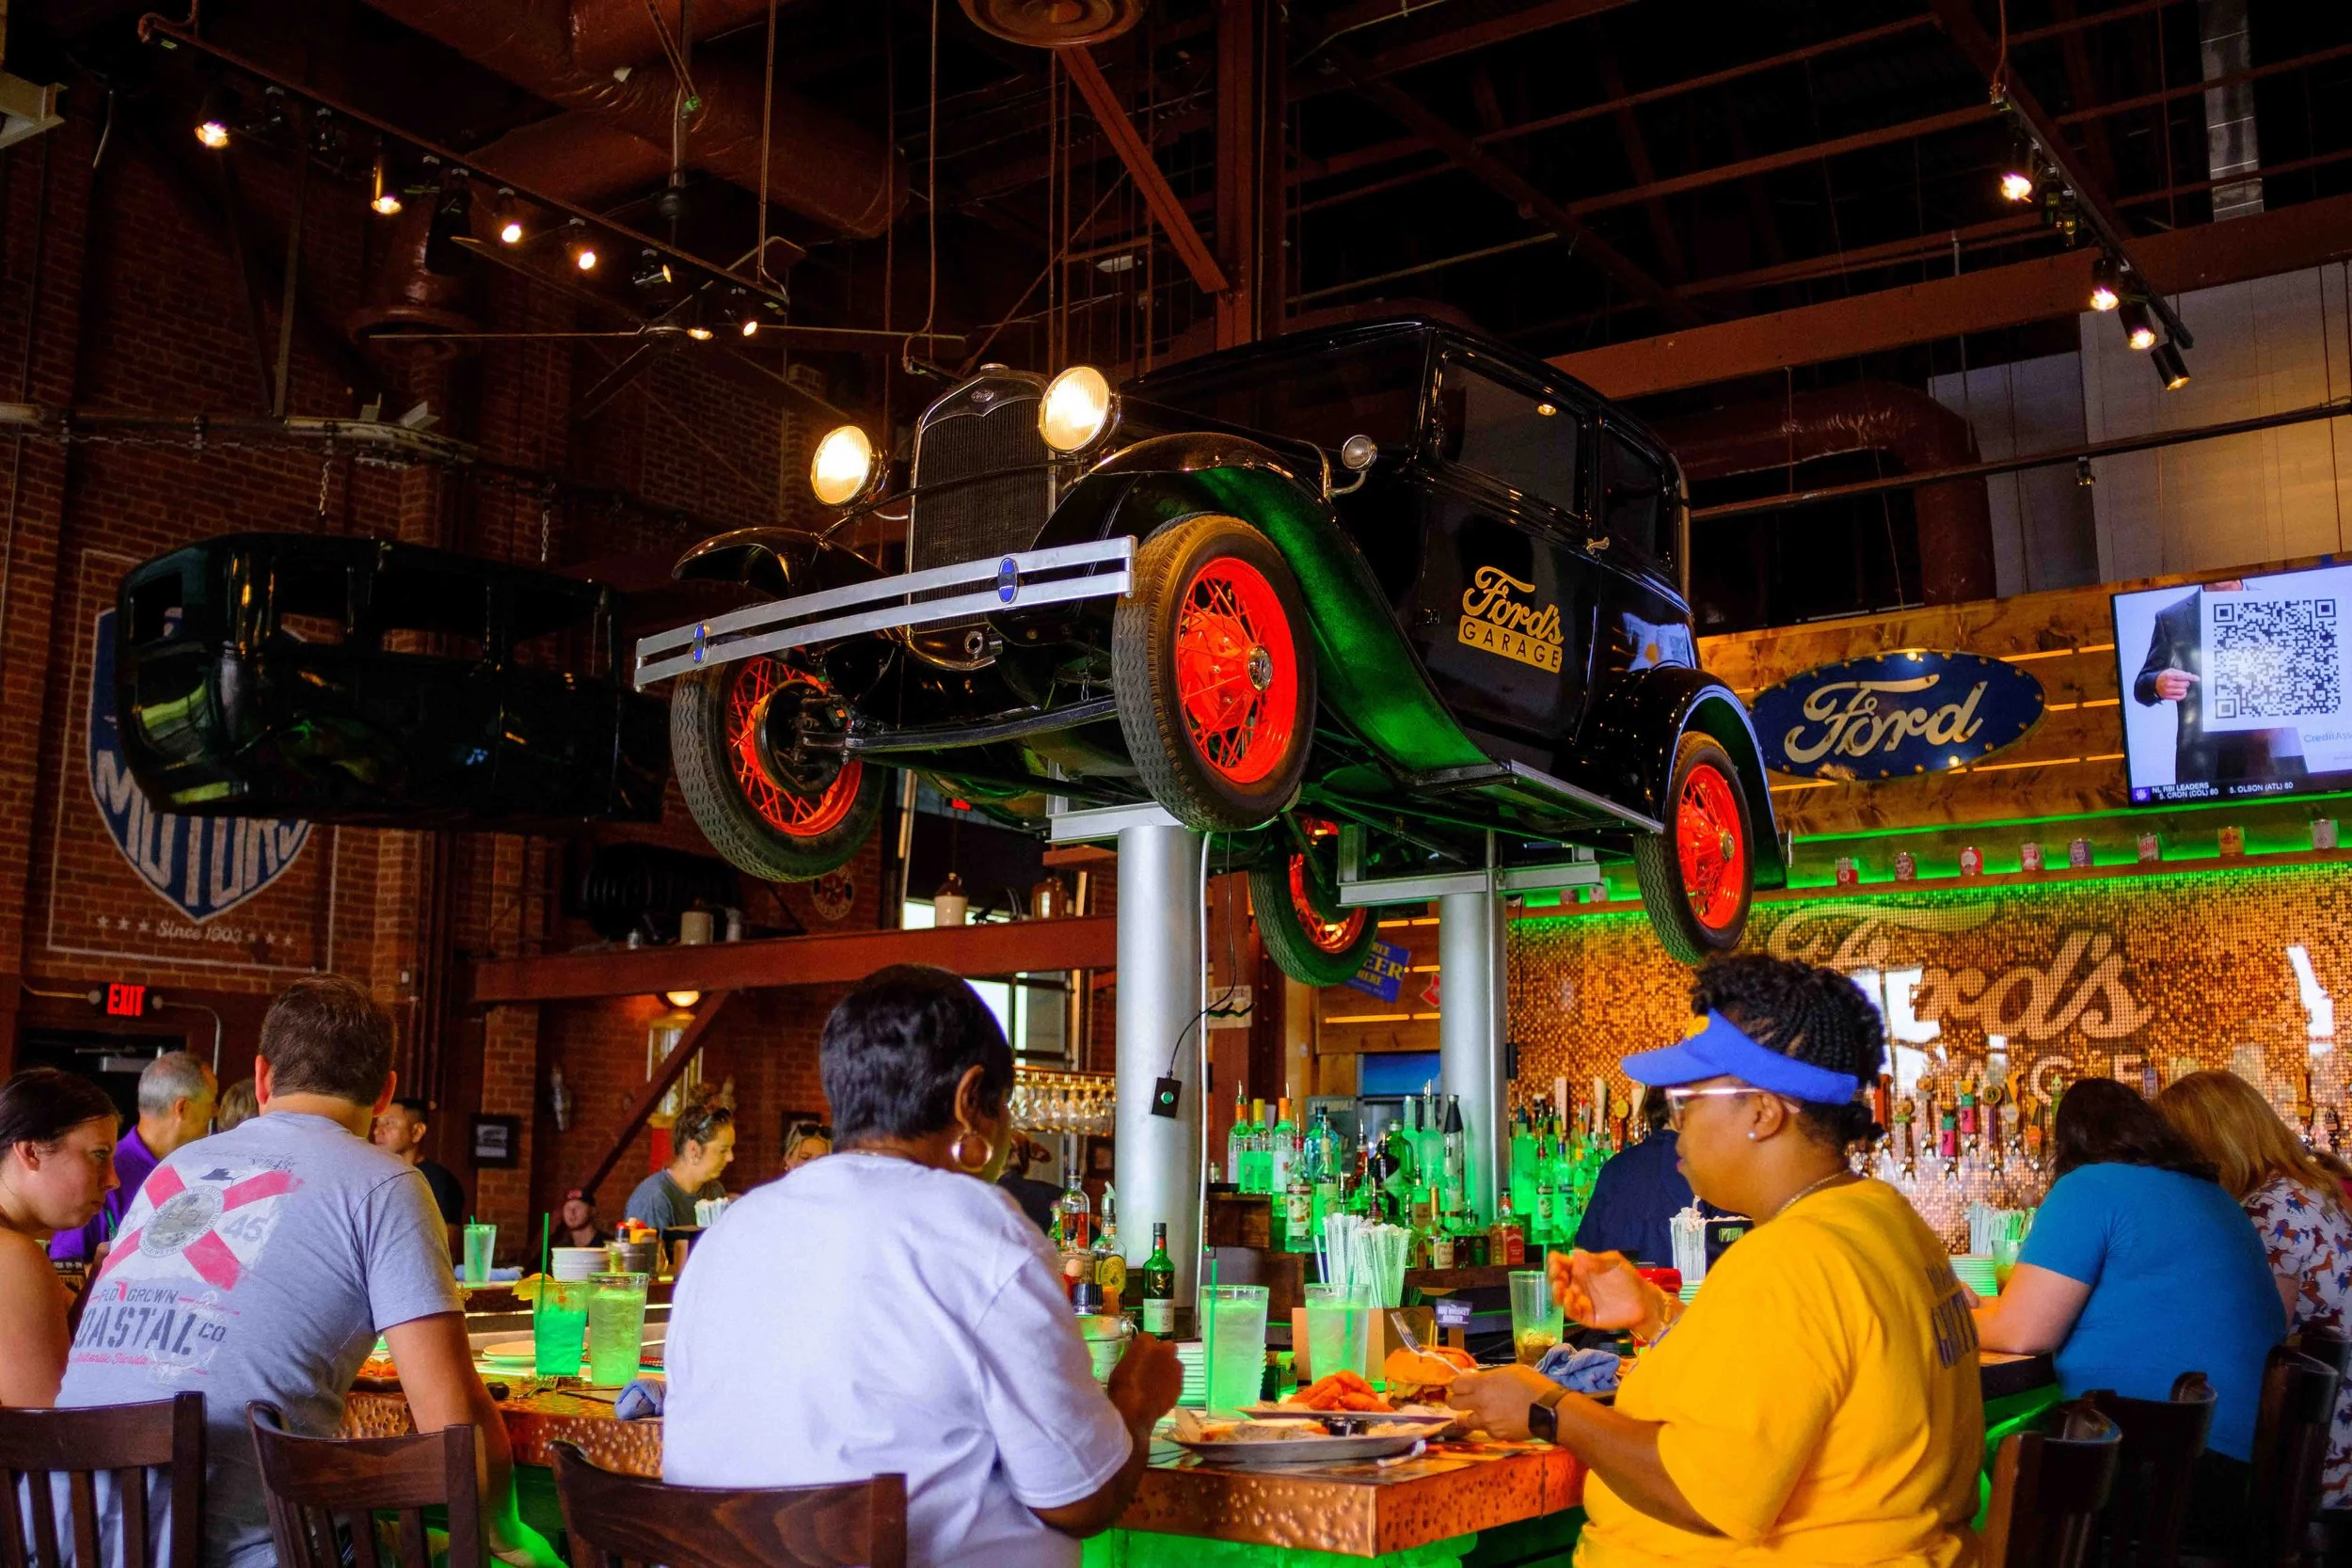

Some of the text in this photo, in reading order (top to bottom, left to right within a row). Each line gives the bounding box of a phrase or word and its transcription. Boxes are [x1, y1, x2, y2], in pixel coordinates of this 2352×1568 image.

[1462, 565, 1565, 645] Ford's
[1463, 621, 1560, 669] GARAGE
[1784, 673, 1988, 764] Ford
[2167, 791, 2187, 800] CRON
[2189, 789, 2208, 798] (COL)
[2176, 782, 2209, 792] LEADERS
[2237, 784, 2263, 793] OLSON
[2265, 783, 2282, 791] (ATL)
[156, 919, 243, 944] Since 1903
[106, 983, 146, 1016] EXIT
[222, 1213, 270, 1243] 45
[126, 1288, 180, 1305] GROWN
[74, 1306, 227, 1355] OASTAL CO.
